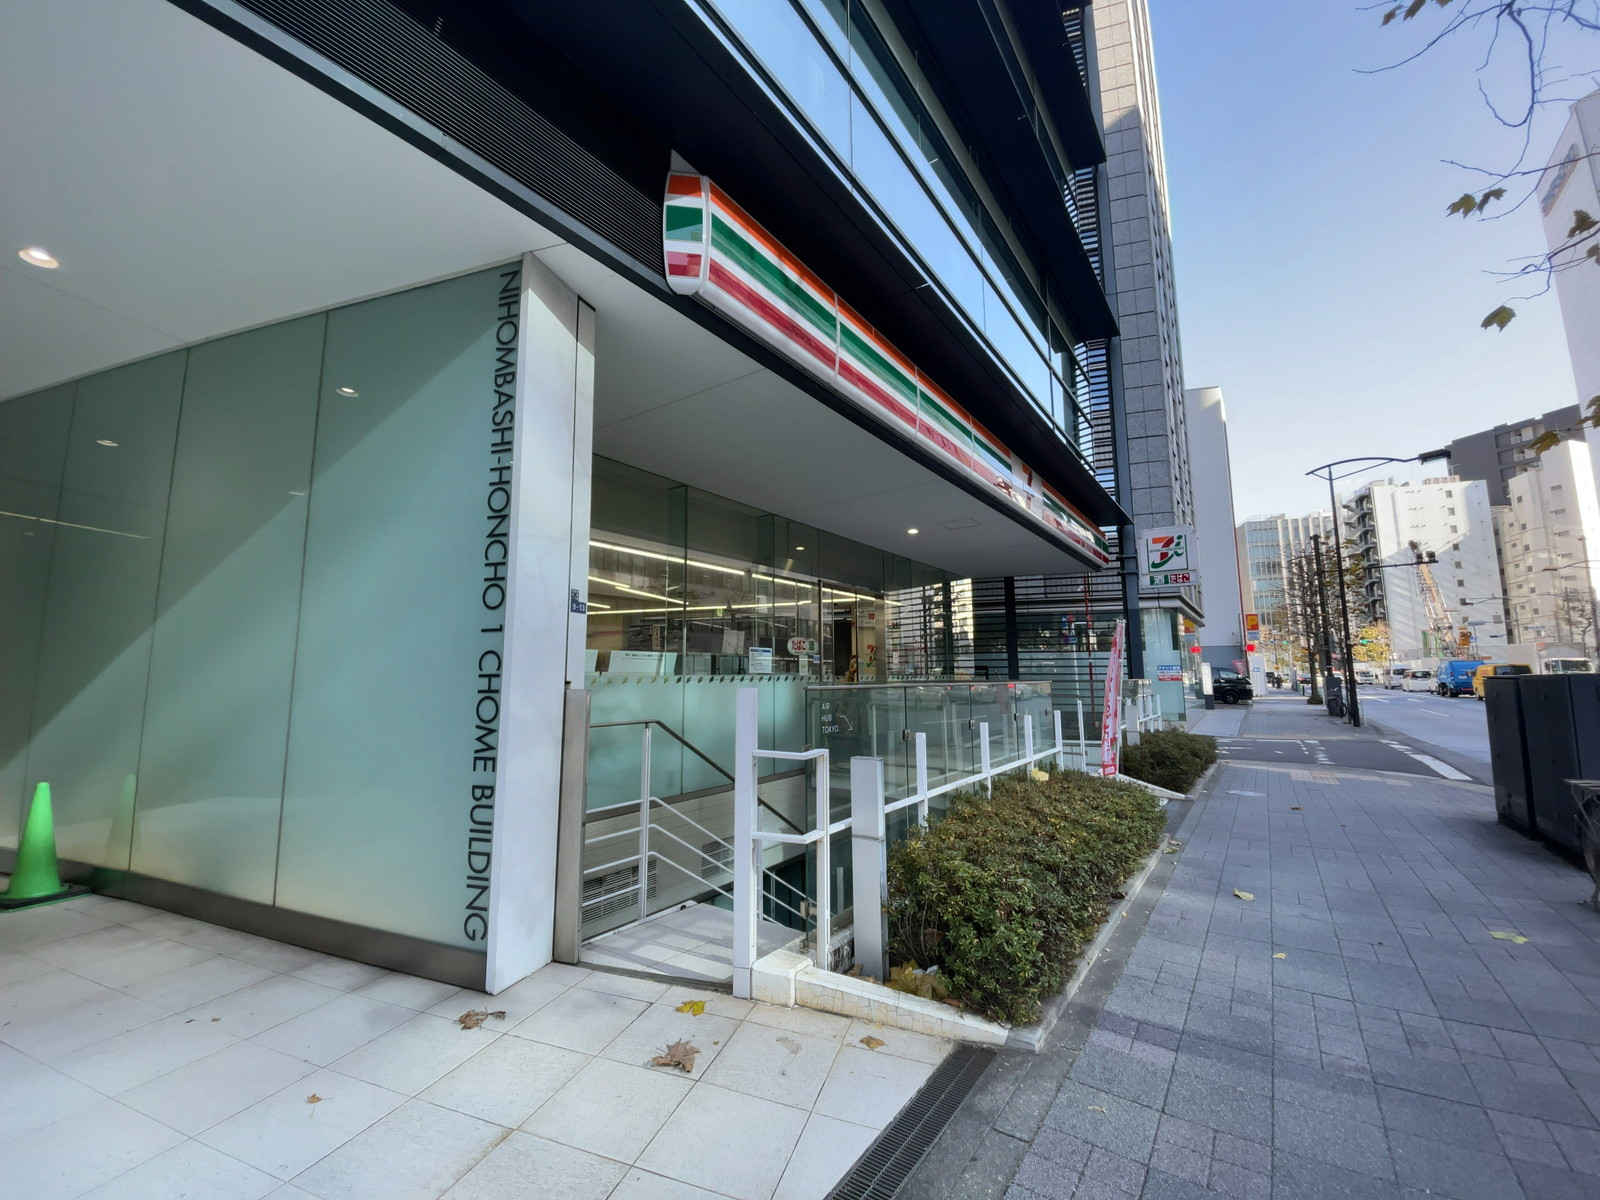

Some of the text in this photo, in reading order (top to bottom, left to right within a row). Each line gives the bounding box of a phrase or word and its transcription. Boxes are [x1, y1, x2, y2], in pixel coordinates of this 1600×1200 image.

[1170, 573, 1190, 584] たばこ
[463, 269, 520, 941] NIHOMBASHI-HONCHO 1 CHOME BUILDING
[1247, 615, 1257, 630] P
[792, 640, 806, 650] たばこ
[821, 702, 830, 710] AIR
[821, 714, 832, 722] HUB
[821, 725, 839, 734] TOKYO
